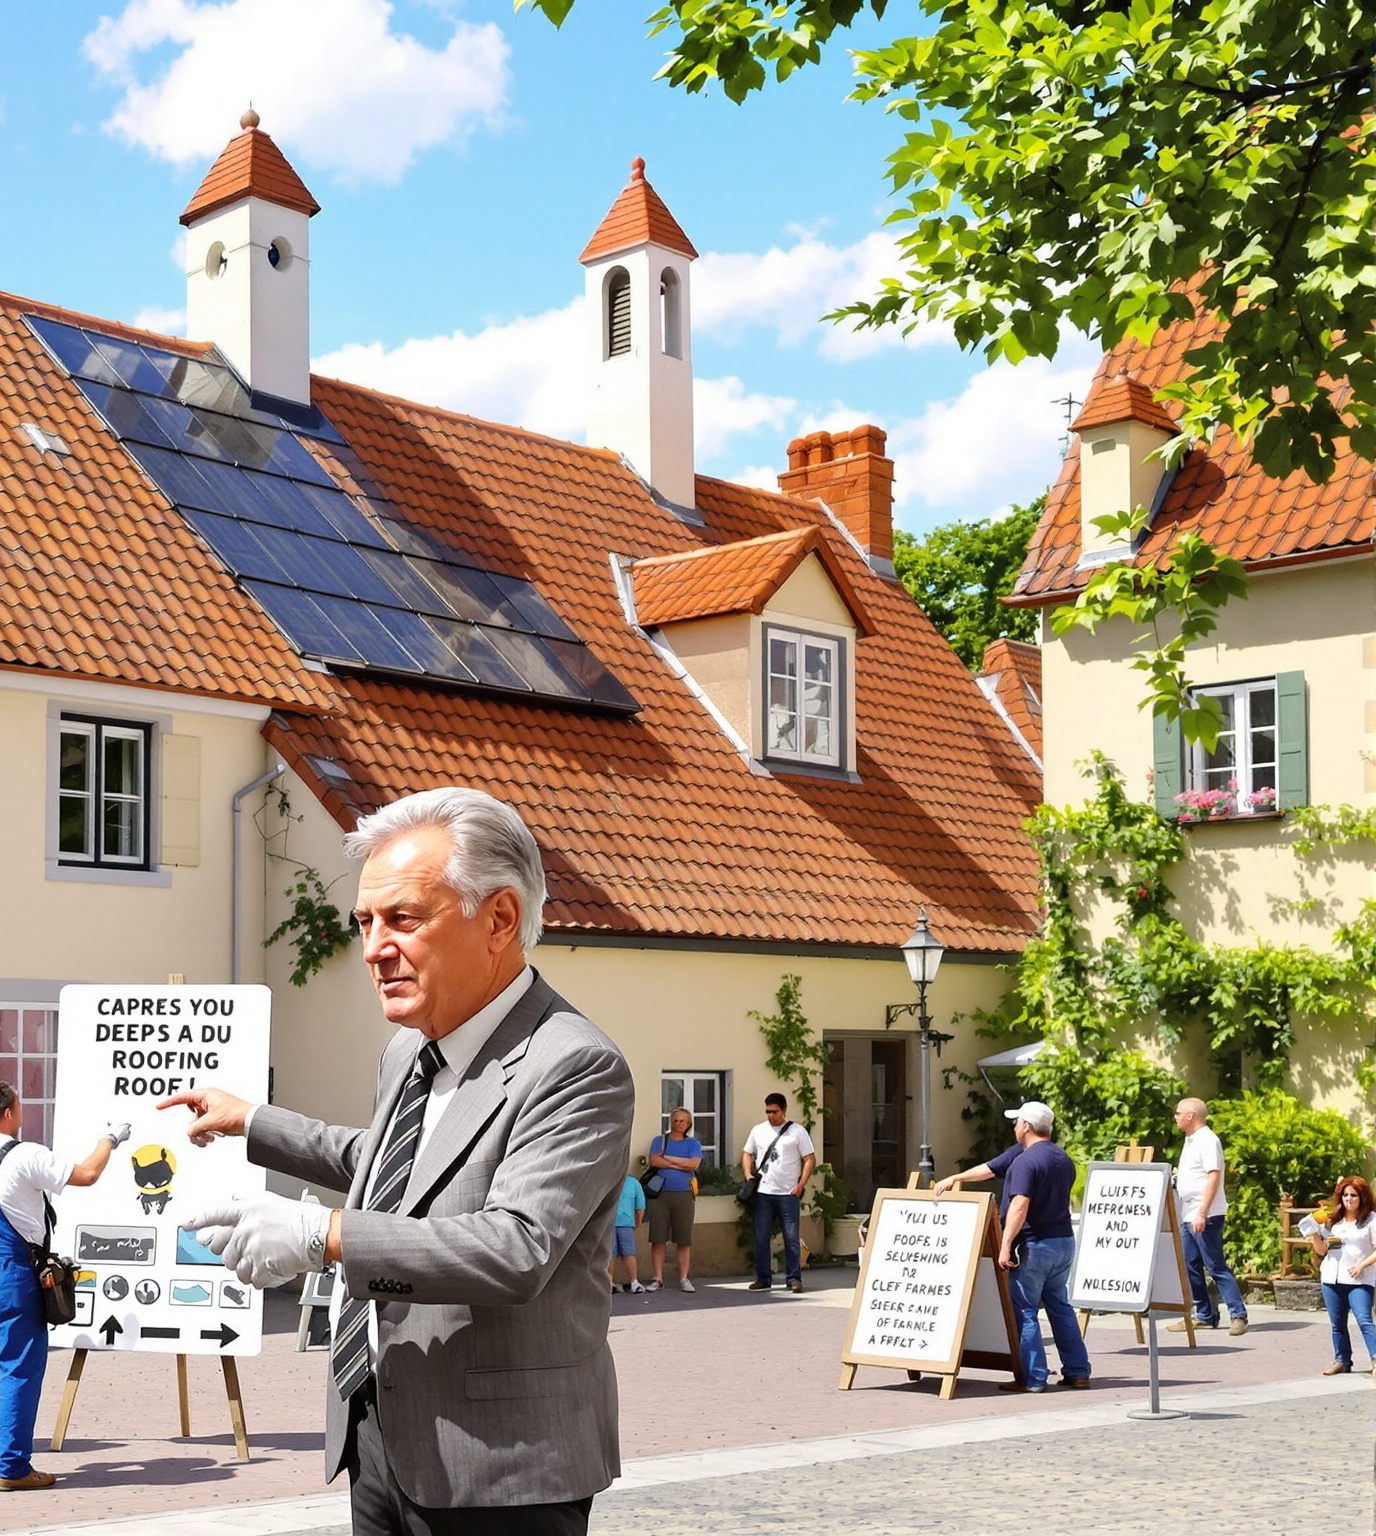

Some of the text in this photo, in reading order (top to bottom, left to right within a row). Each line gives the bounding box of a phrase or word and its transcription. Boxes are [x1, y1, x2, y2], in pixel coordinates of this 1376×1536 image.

[98, 999, 233, 1016] CAPRES YOU
[96, 1024, 230, 1043] DEEPS A DU
[113, 1051, 218, 1069] ROOFING
[1096, 1237, 1140, 1249] MY OUT
[868, 1335, 875, 1345] A
